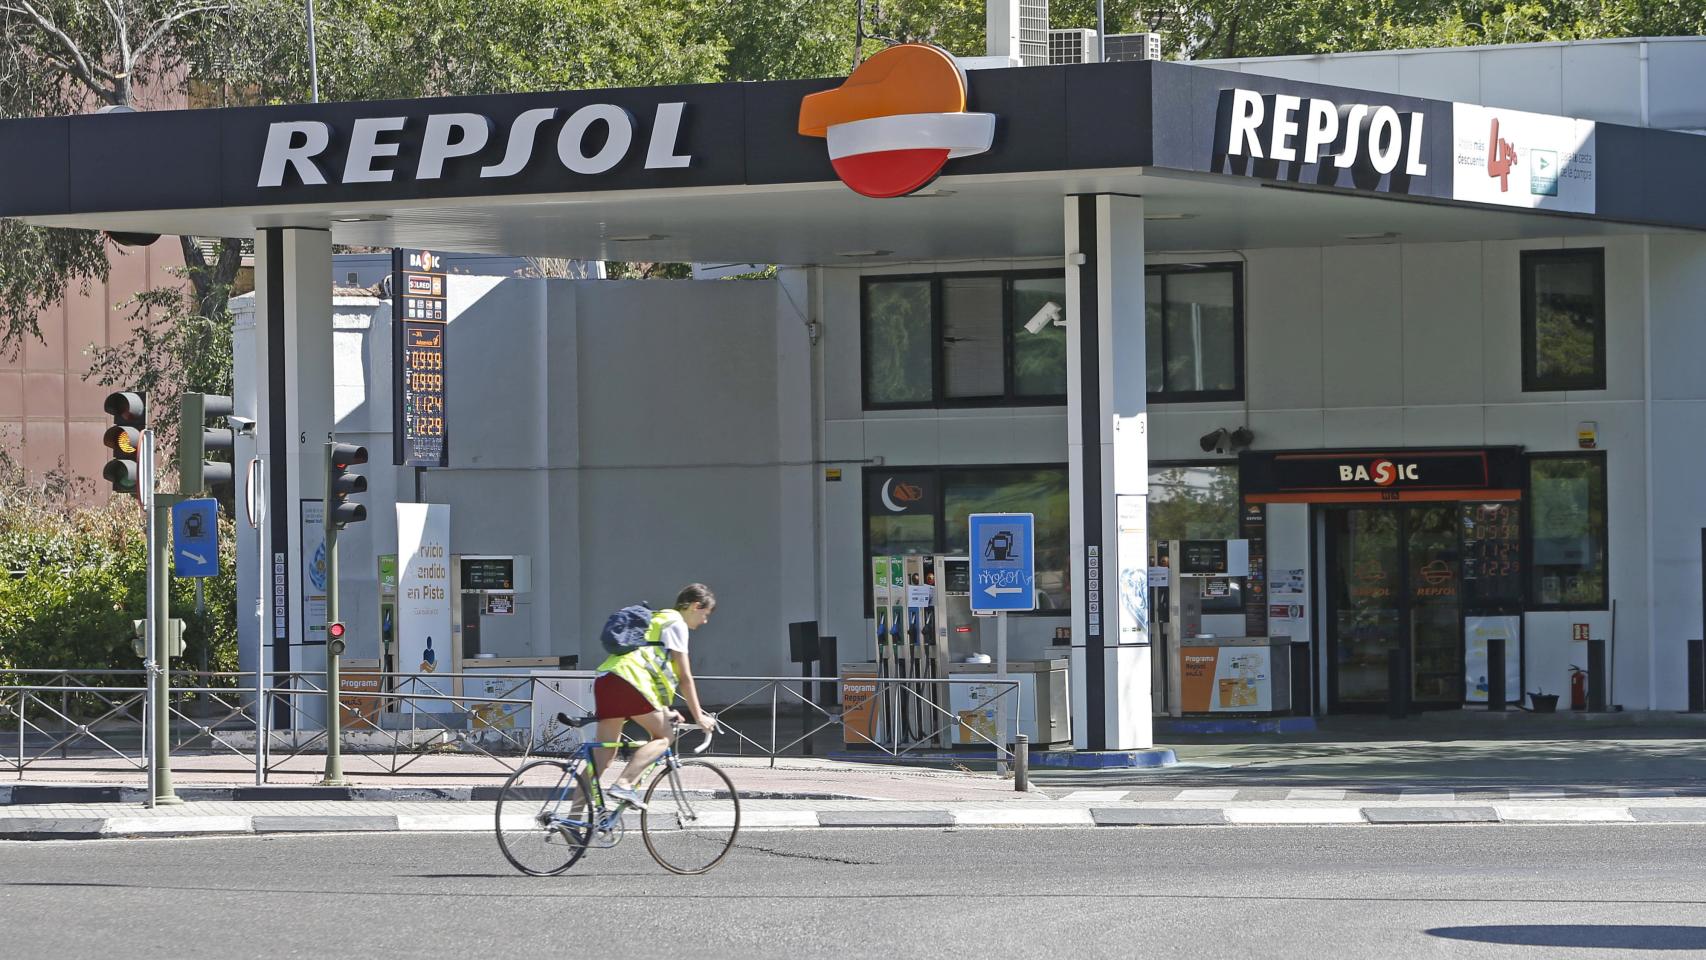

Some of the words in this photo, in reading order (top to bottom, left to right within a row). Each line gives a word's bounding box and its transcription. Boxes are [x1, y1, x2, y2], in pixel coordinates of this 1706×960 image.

[1227, 88, 1428, 177] REPSOL
[257, 101, 692, 188] REPSOL
[409, 250, 440, 271] BASIC
[300, 431, 306, 443] 6
[1339, 460, 1419, 485] BASIC
[422, 584, 445, 600] Pista
[1416, 587, 1457, 597] REPSOL
[1184, 655, 1215, 664] Programa
[341, 679, 378, 694] Programa
[843, 684, 876, 695] Programa
